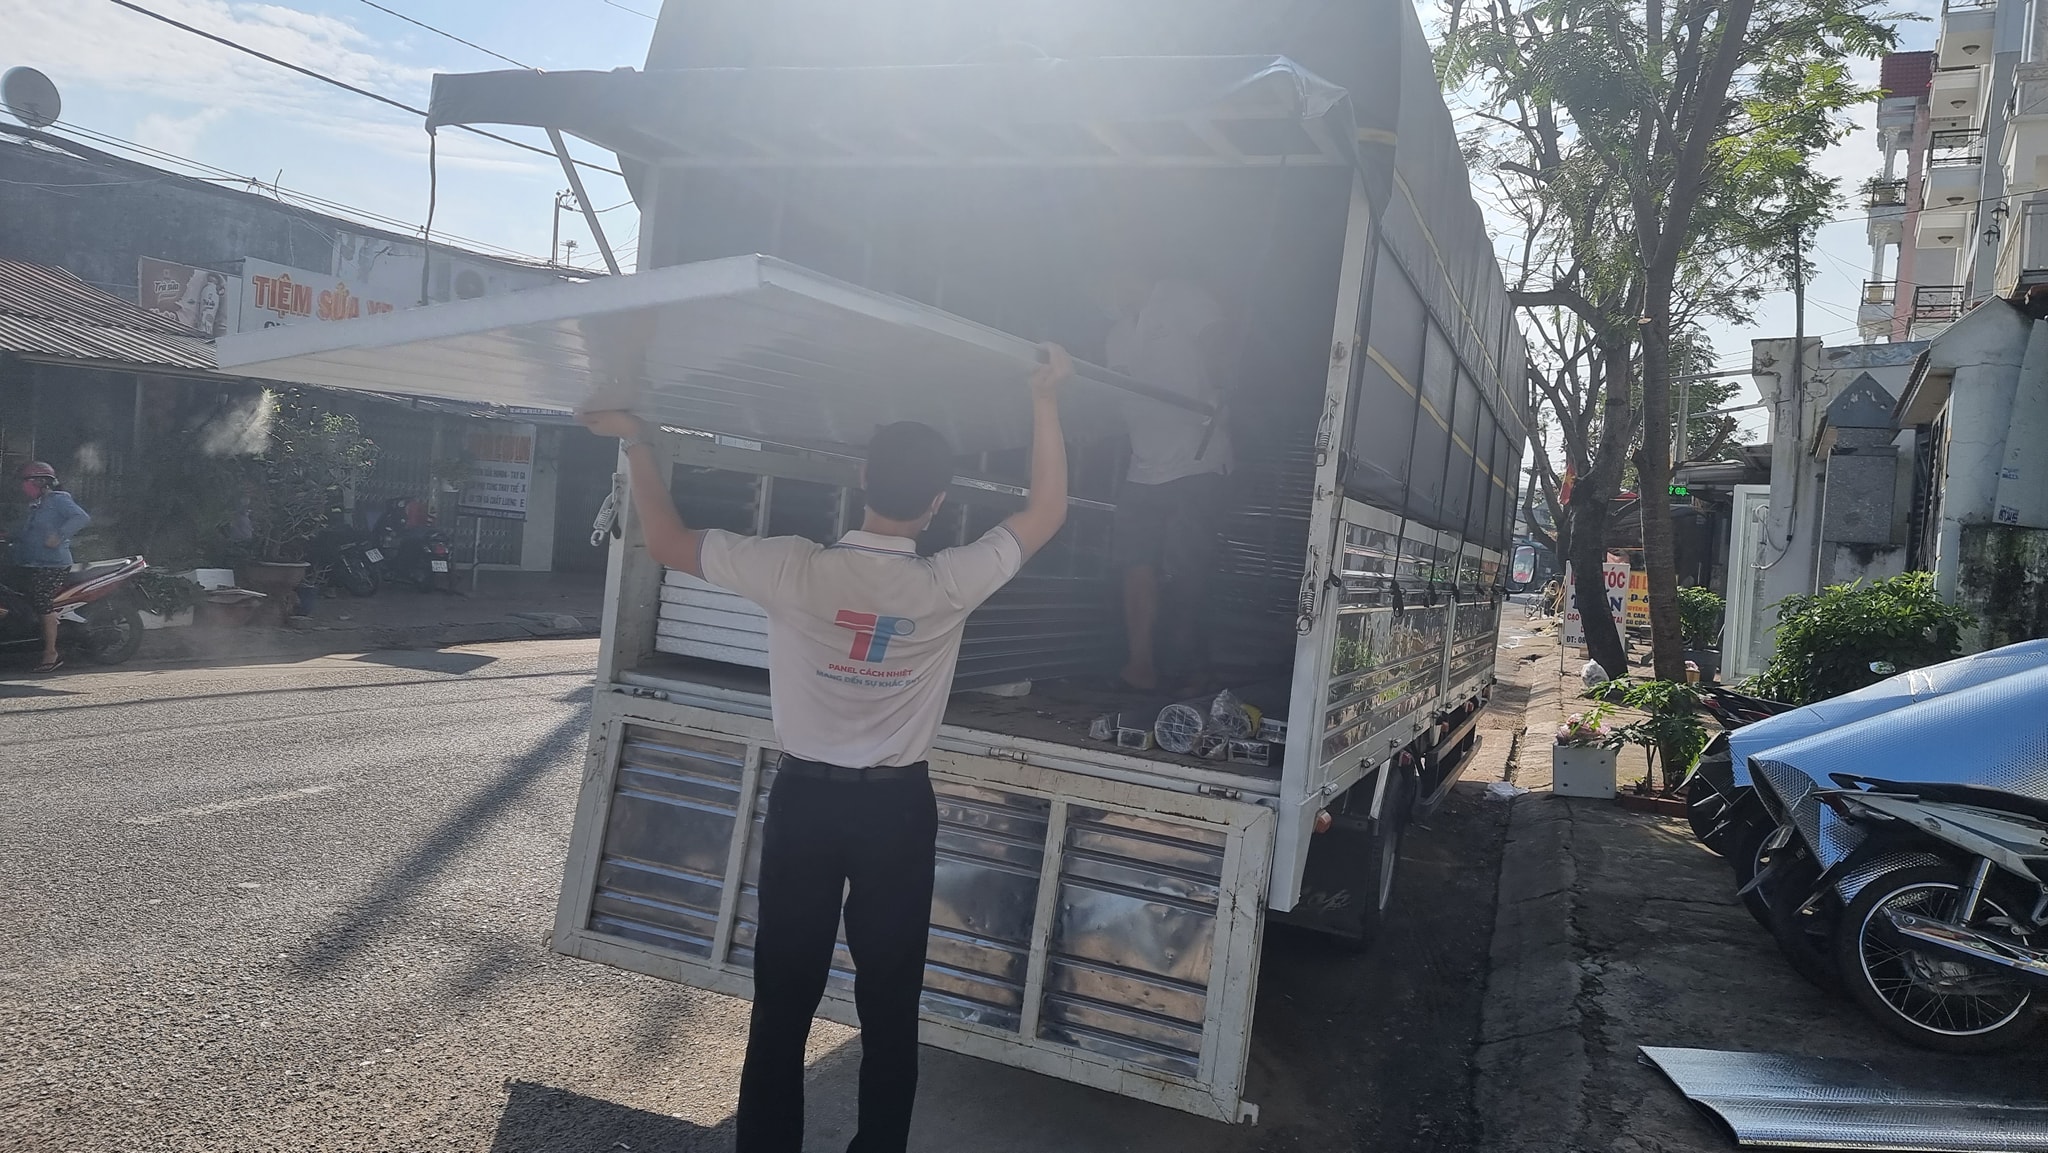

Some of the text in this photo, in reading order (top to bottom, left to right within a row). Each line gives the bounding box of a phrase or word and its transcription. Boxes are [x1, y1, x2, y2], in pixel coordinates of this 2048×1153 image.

[252, 273, 313, 319] TIỆM
[317, 281, 360, 321] SỬA
[816, 669, 842, 682] MANG
[844, 675, 863, 686] ĐẾN
[864, 679, 878, 689] SỰ
[879, 678, 905, 688] KHÁC
[828, 663, 914, 679] PANEL CÁCH NHIỆT
